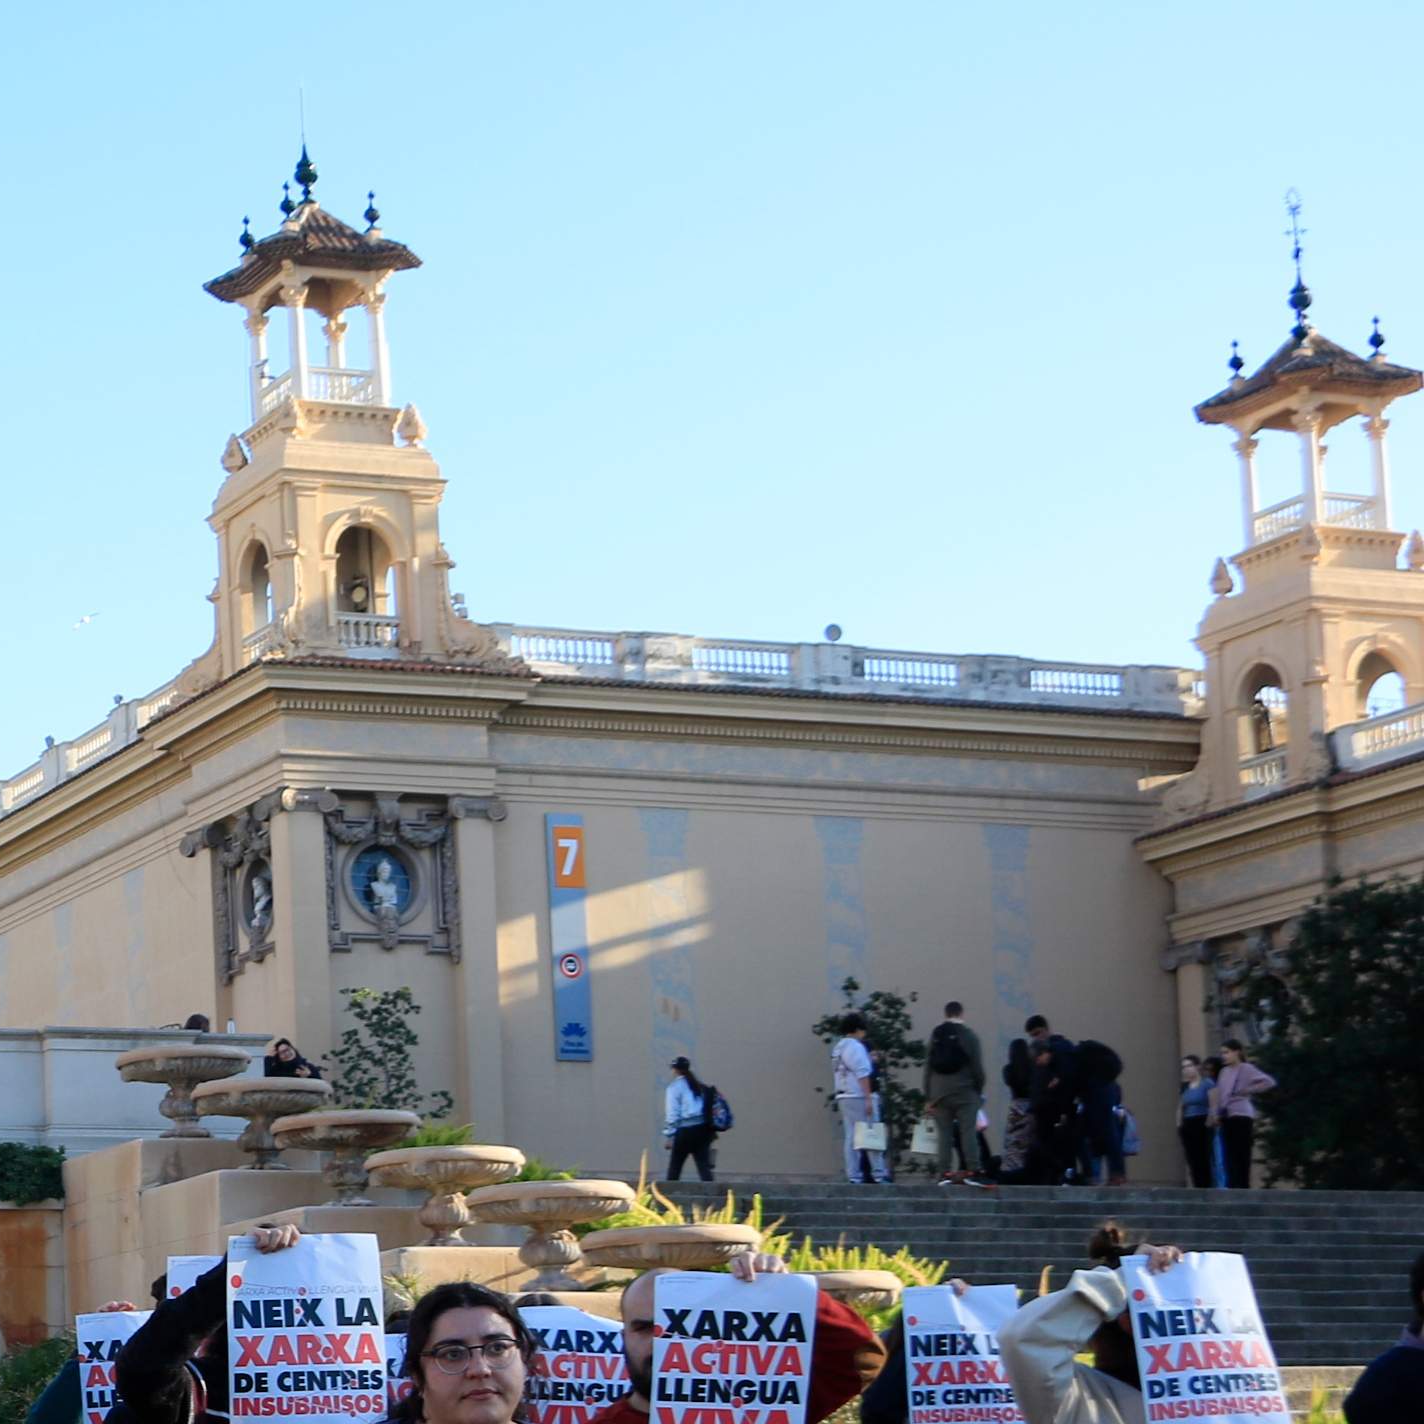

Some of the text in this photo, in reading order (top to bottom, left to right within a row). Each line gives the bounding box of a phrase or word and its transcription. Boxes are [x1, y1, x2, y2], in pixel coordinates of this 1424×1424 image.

[558, 839, 578, 876] 7
[233, 1297, 379, 1329] NEIX LA
[661, 1309, 806, 1342] XARXA
[1138, 1308, 1221, 1339] NEIX
[234, 1333, 381, 1367] XARXA
[529, 1328, 624, 1354] XARX
[910, 1333, 1000, 1357] NEIX L
[528, 1353, 631, 1380] ACTIV
[659, 1342, 803, 1376] ACTIVA
[1143, 1340, 1272, 1374] XARXA
[234, 1372, 268, 1393] DE
[277, 1370, 383, 1392] CENTRES
[912, 1361, 1014, 1386] XARX
[1147, 1373, 1278, 1399] DE CENTRES
[524, 1381, 632, 1402] LLENGU
[657, 1377, 800, 1404] LLENGUA
[912, 1388, 1014, 1406] DE CENTRE
[233, 1394, 384, 1416] INSUBMISOS
[912, 1407, 1025, 1424] INSUBMISOS
[1147, 1396, 1283, 1421] INSUBMISOS
